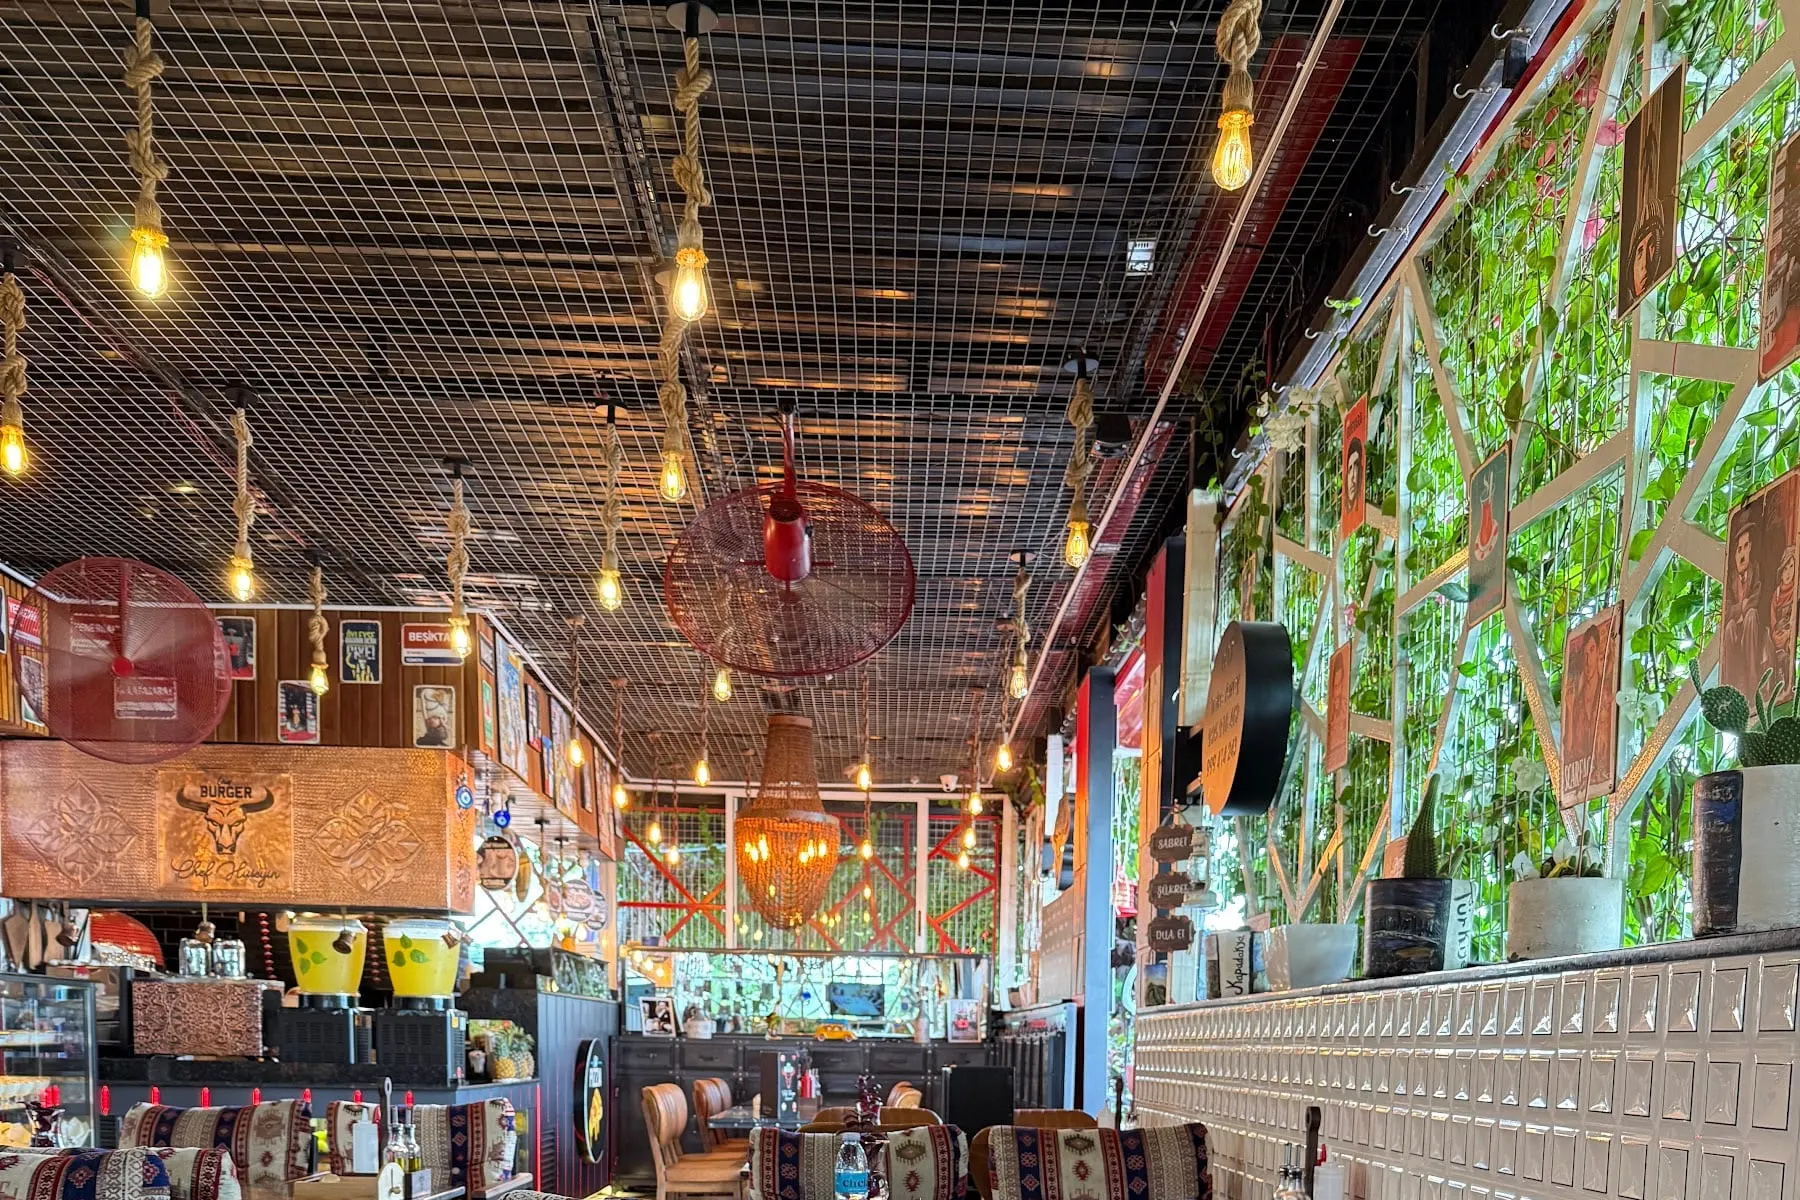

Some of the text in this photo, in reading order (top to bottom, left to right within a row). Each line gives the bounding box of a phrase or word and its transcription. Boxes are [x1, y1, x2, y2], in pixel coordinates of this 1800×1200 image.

[408, 629, 450, 644] BEŞİKTA
[1564, 755, 1591, 791] SCARFAC
[200, 785, 252, 799] BURGER
[1158, 836, 1188, 850] SABRET
[170, 858, 216, 887] Chef
[1155, 928, 1185, 941] DUA ET
[1225, 934, 1249, 996] Kapadokya
